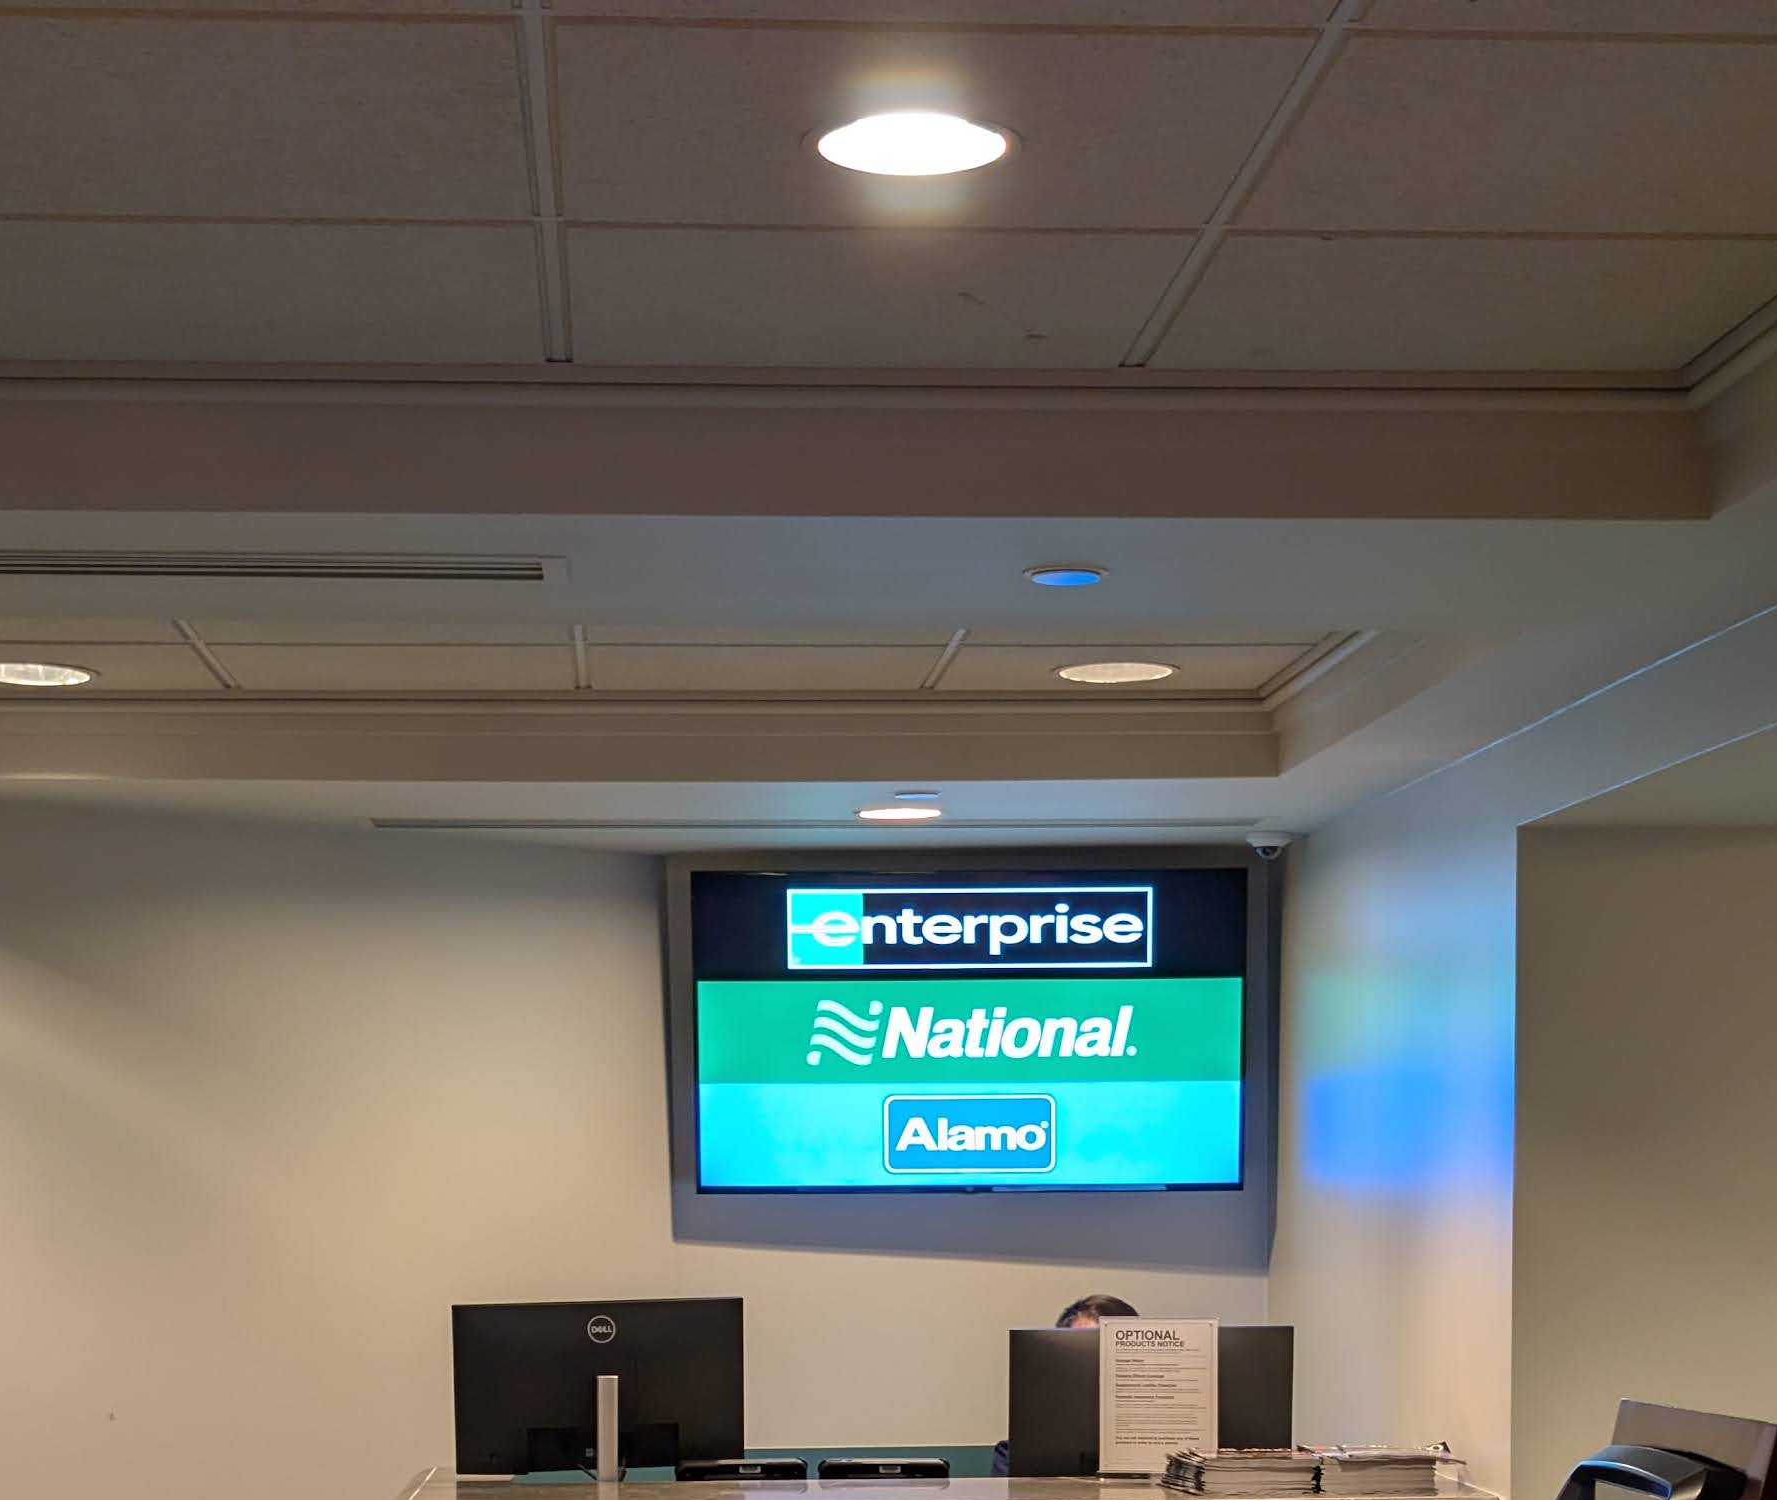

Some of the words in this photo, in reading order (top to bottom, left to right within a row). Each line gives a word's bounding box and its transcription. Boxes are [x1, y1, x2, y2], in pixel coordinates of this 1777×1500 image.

[813, 903, 1144, 955] enterprise
[895, 1116, 1048, 1152] Alamo
[591, 1325, 613, 1334] DELL
[1115, 1330, 1180, 1341] OPTIONAL
